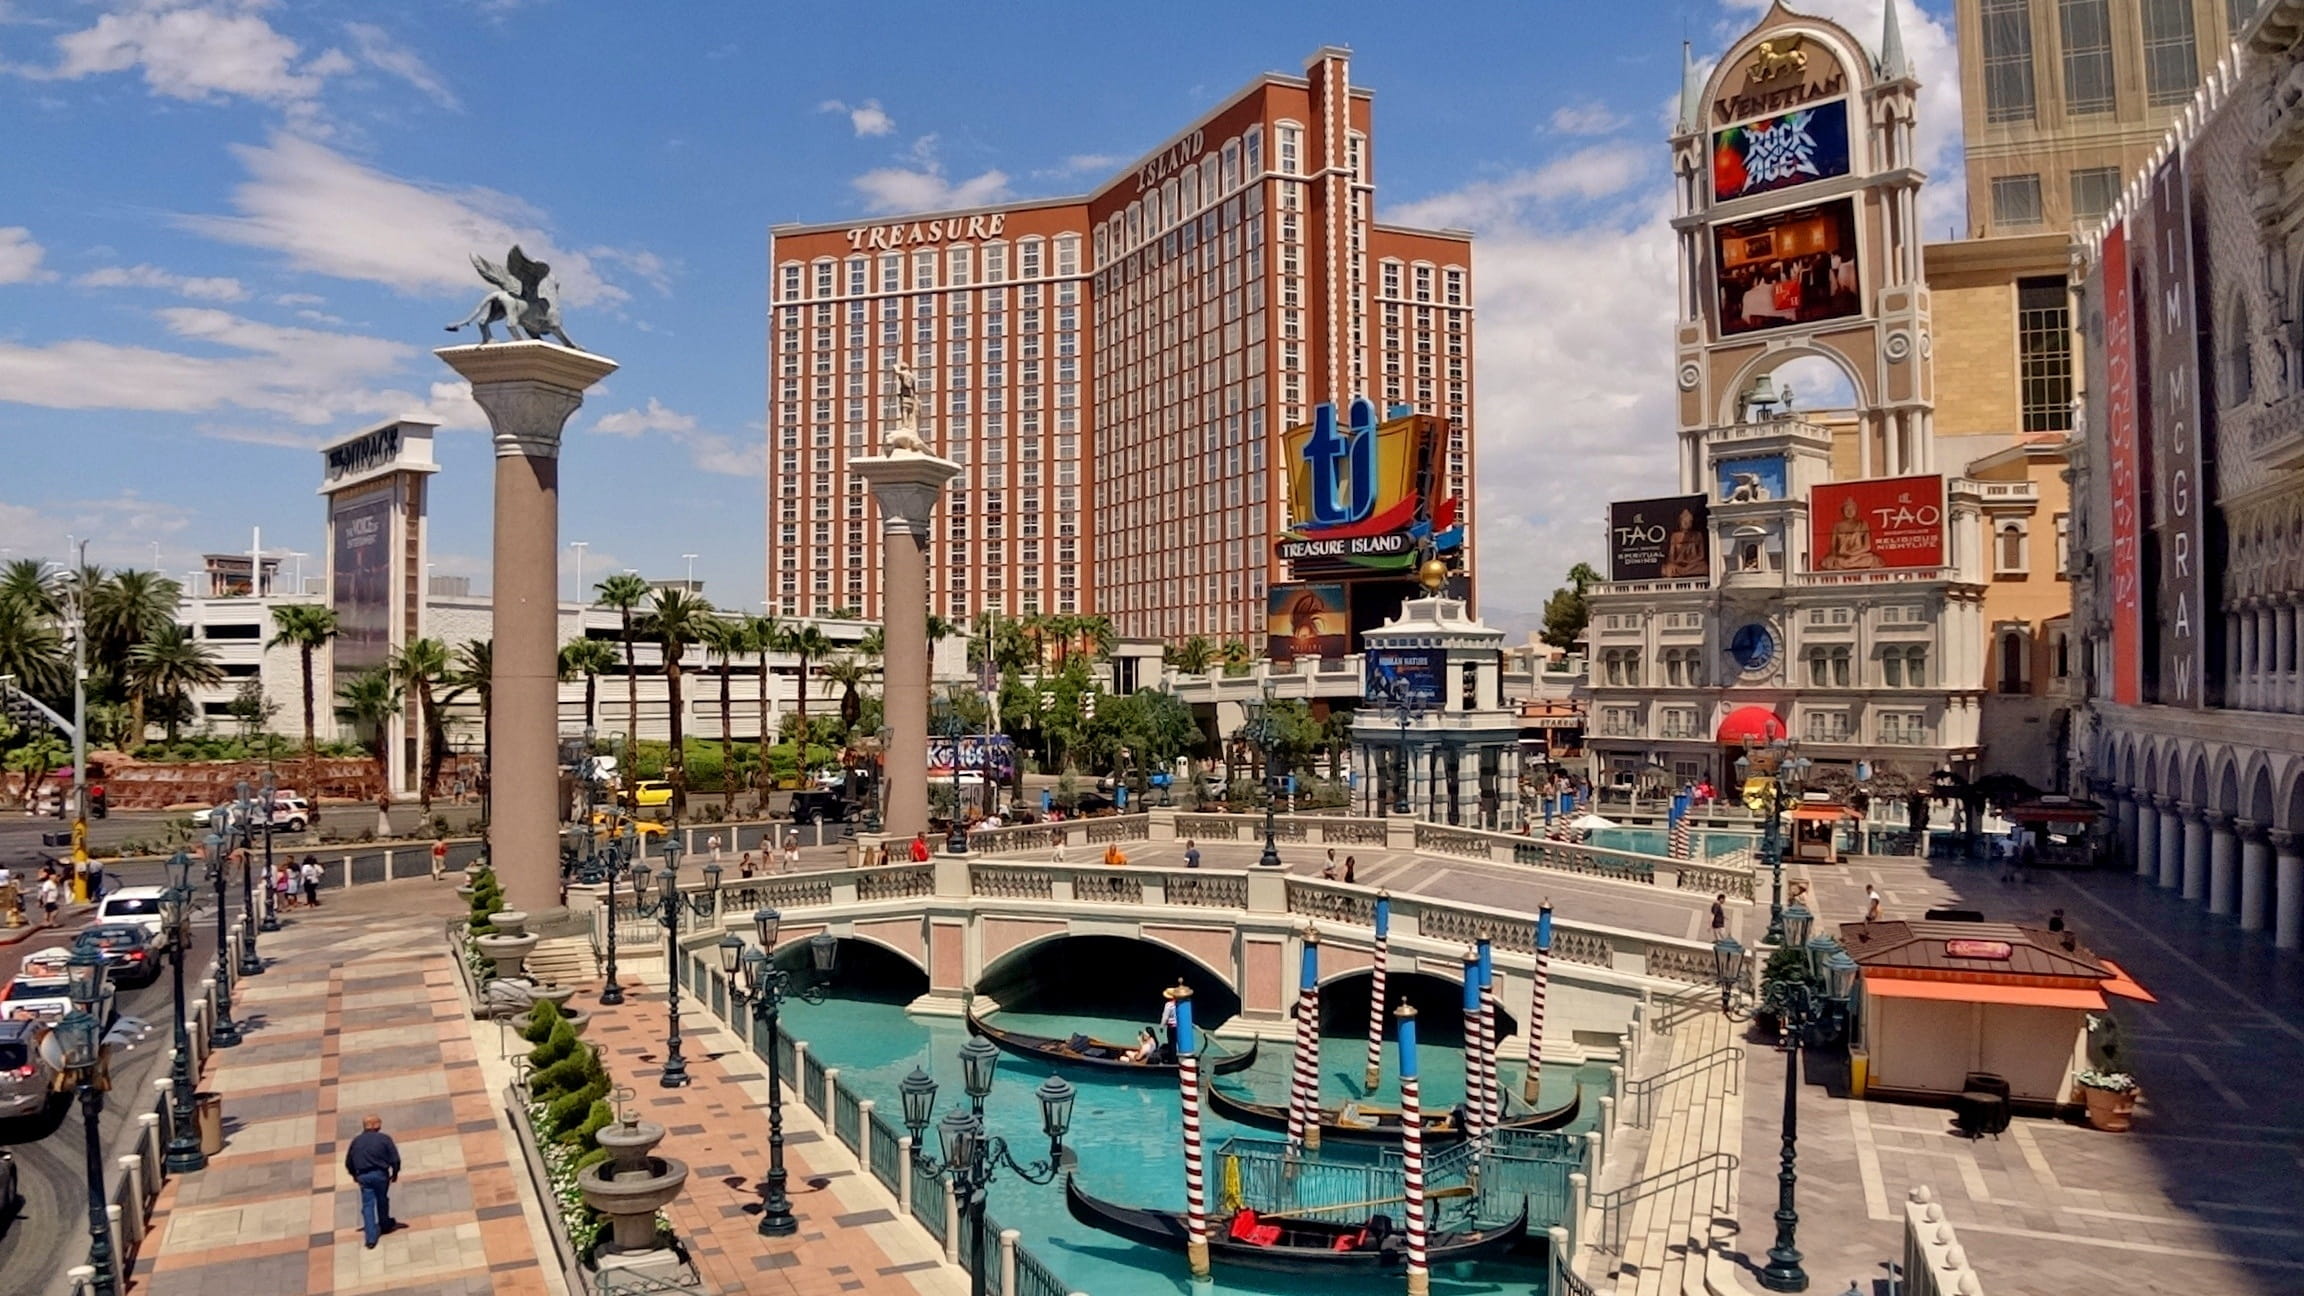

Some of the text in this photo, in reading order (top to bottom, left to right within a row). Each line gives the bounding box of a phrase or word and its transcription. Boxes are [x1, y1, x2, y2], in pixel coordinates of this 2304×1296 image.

[1714, 73, 1842, 124] VENETIAN
[1741, 110, 1818, 165] ROCK
[1136, 128, 1204, 193] ISLAND
[1742, 145, 1820, 192] AGES
[847, 213, 1006, 250] TREASURE
[2159, 162, 2182, 335] TIM
[1614, 524, 1666, 546] TAO
[1873, 504, 1940, 529] TAO
[1282, 535, 1402, 558] TREASURE ISLAND
[1540, 719, 1578, 728] STARBU
